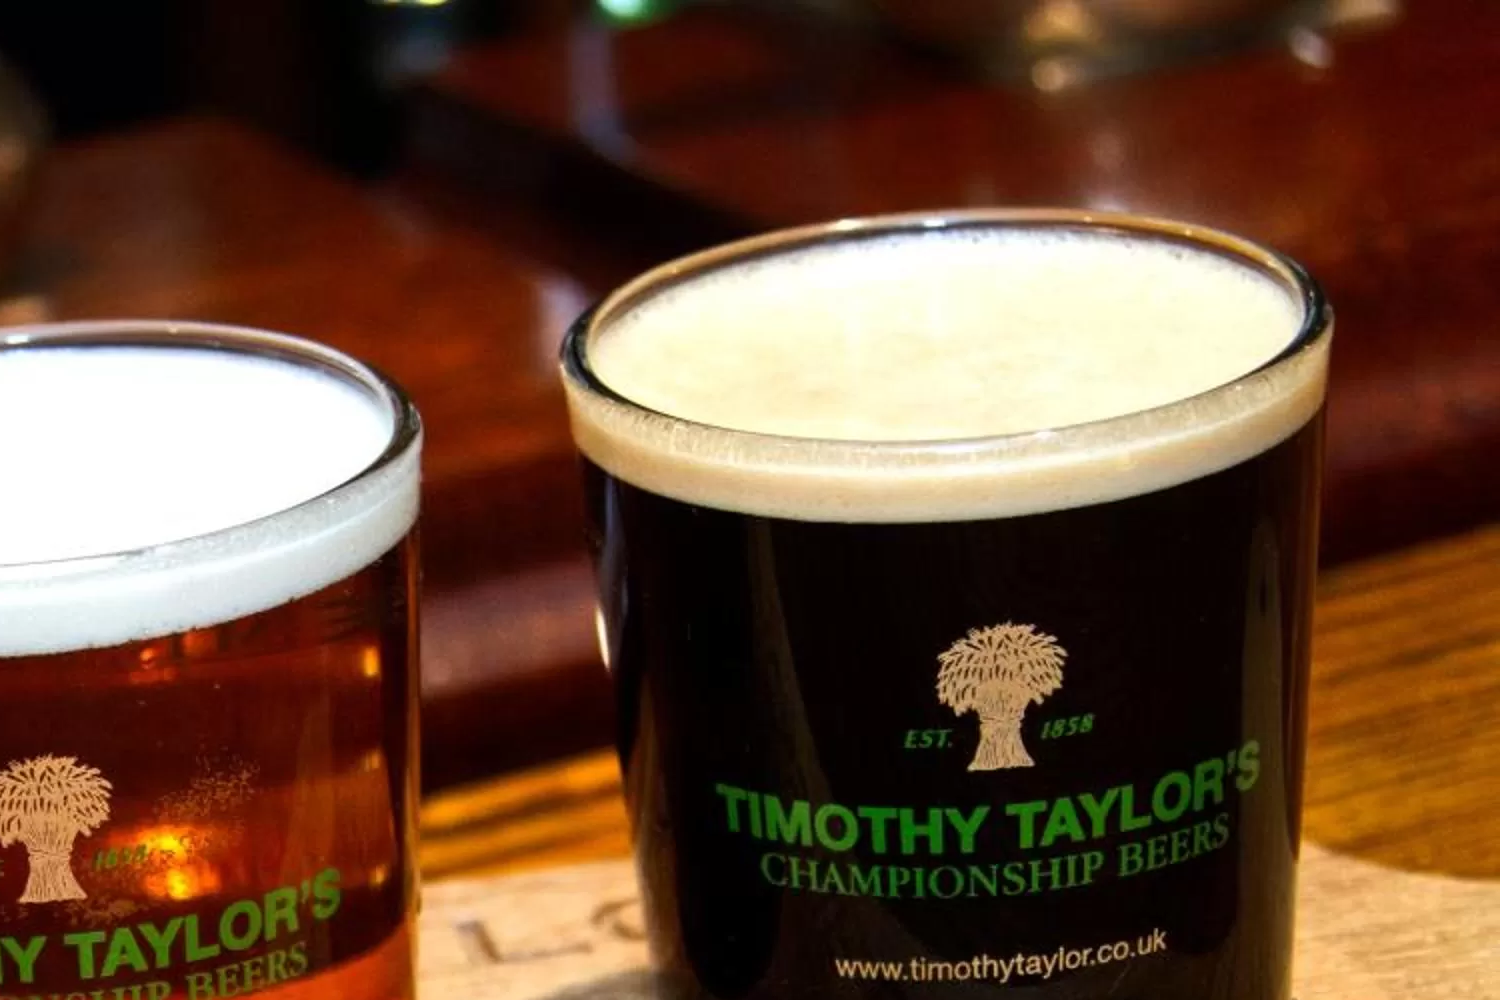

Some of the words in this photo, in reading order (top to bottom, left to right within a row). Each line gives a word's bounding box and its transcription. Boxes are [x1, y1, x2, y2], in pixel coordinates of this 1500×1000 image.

[904, 727, 954, 750] EST.
[1040, 712, 1096, 741] 1858
[715, 782, 991, 855] TIMOTHY
[1004, 739, 1262, 850] TAYLOR'S
[759, 850, 1106, 900] CHAMPIONSHIP
[1117, 811, 1232, 879] BEERS
[62, 866, 344, 980] TAYLOR'S
[834, 927, 1168, 984] www.timothytaylor.co.uk
